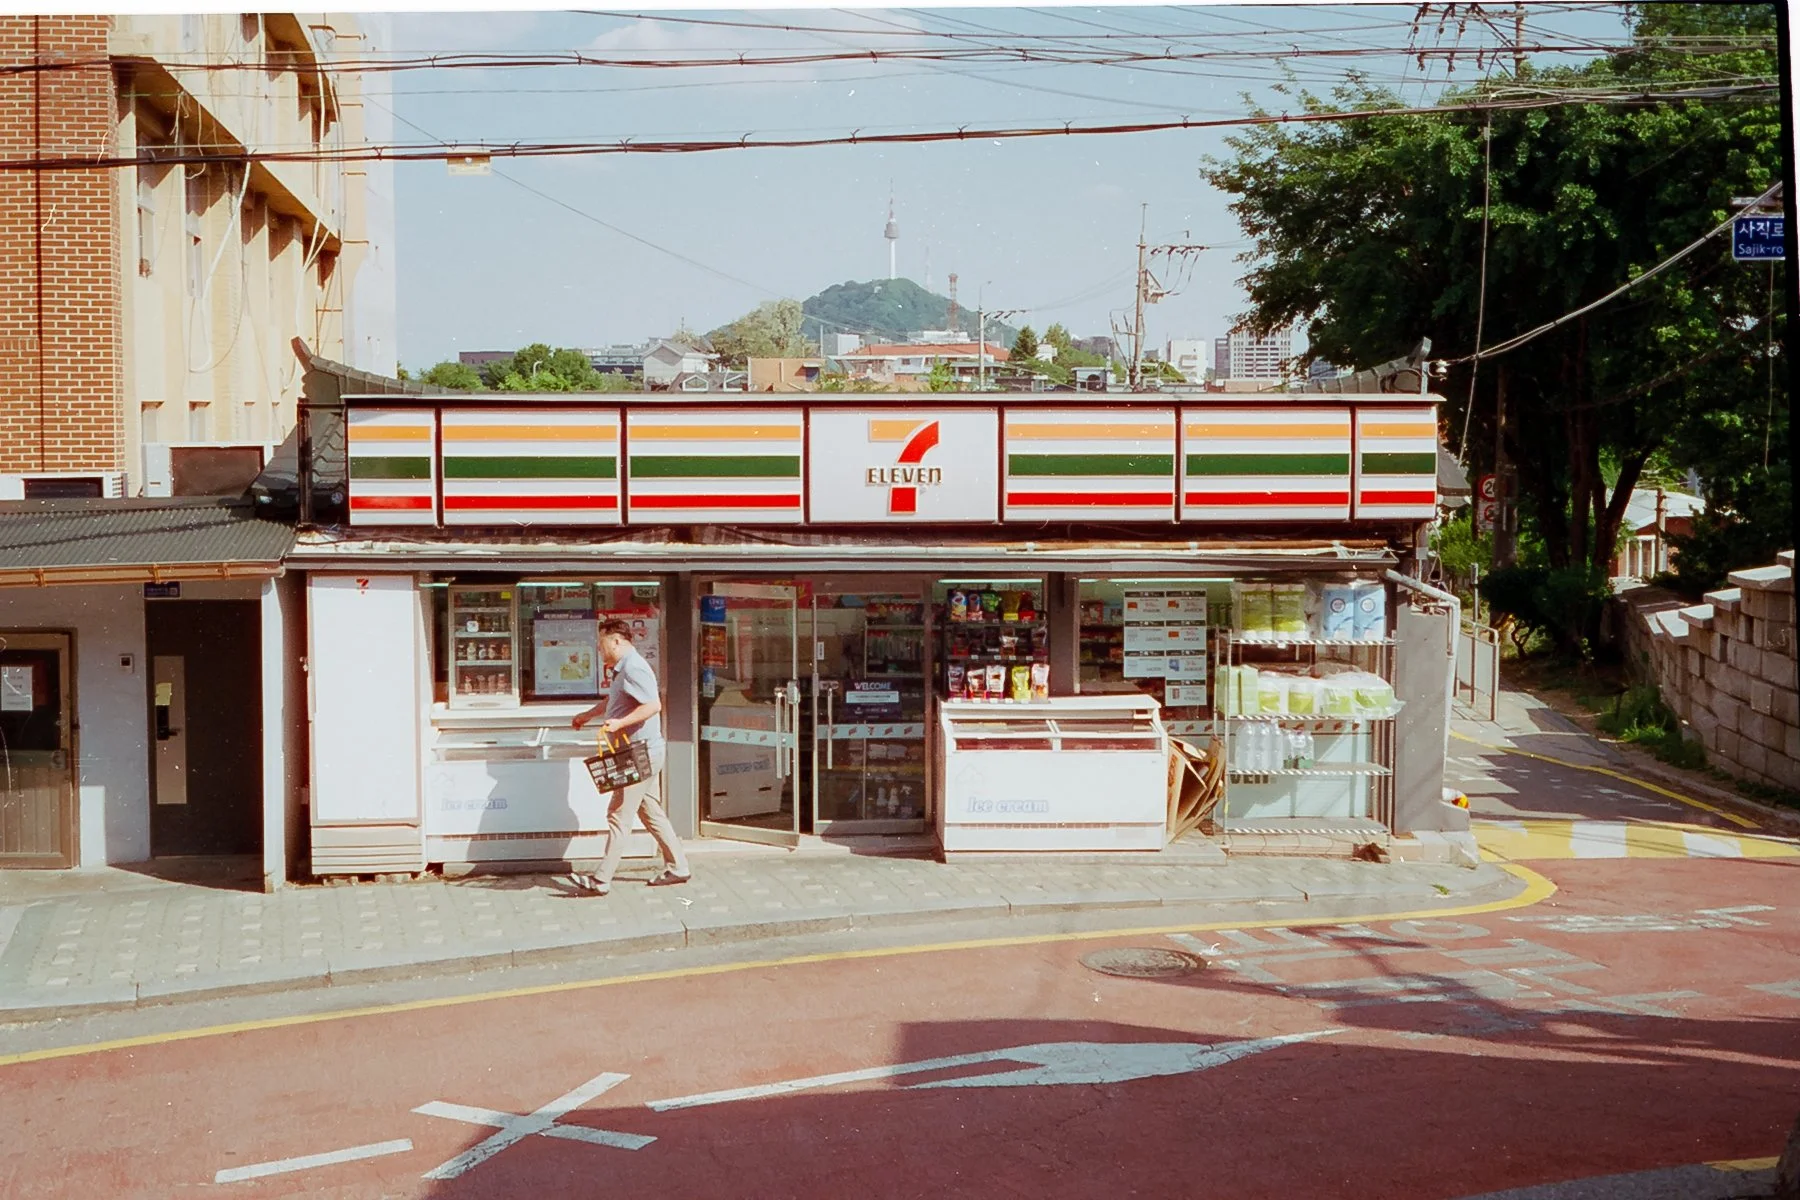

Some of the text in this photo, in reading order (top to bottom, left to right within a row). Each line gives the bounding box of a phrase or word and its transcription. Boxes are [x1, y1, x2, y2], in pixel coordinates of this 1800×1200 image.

[1739, 220, 1785, 239] 사직로
[1738, 243, 1784, 257] Sajik-ro
[854, 681, 892, 690] WELCOME
[996, 799, 1048, 814] cream
